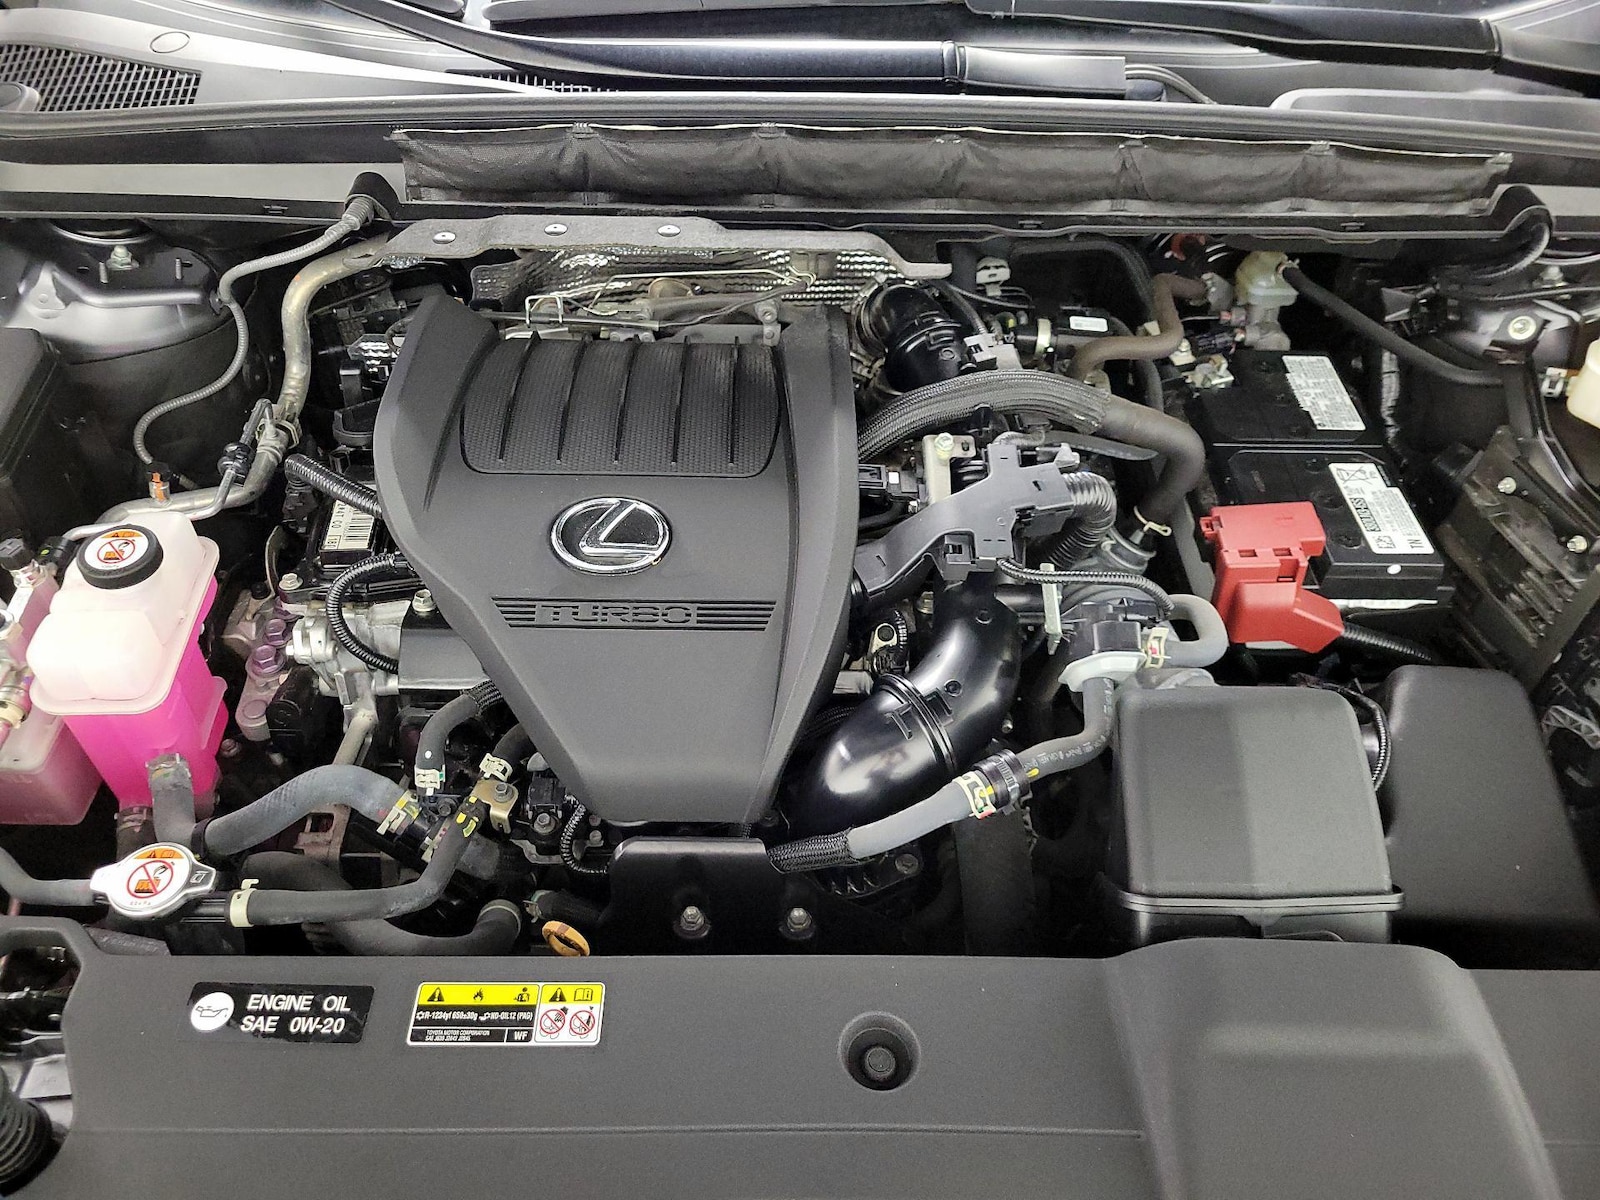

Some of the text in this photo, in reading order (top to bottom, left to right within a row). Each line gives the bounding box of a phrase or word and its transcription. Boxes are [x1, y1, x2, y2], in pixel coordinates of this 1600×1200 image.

[541, 605, 692, 624] TURBO
[246, 994, 351, 1012] ENGINE OIL
[240, 1015, 346, 1034] SAE 0W-20
[514, 1031, 528, 1041] WF
